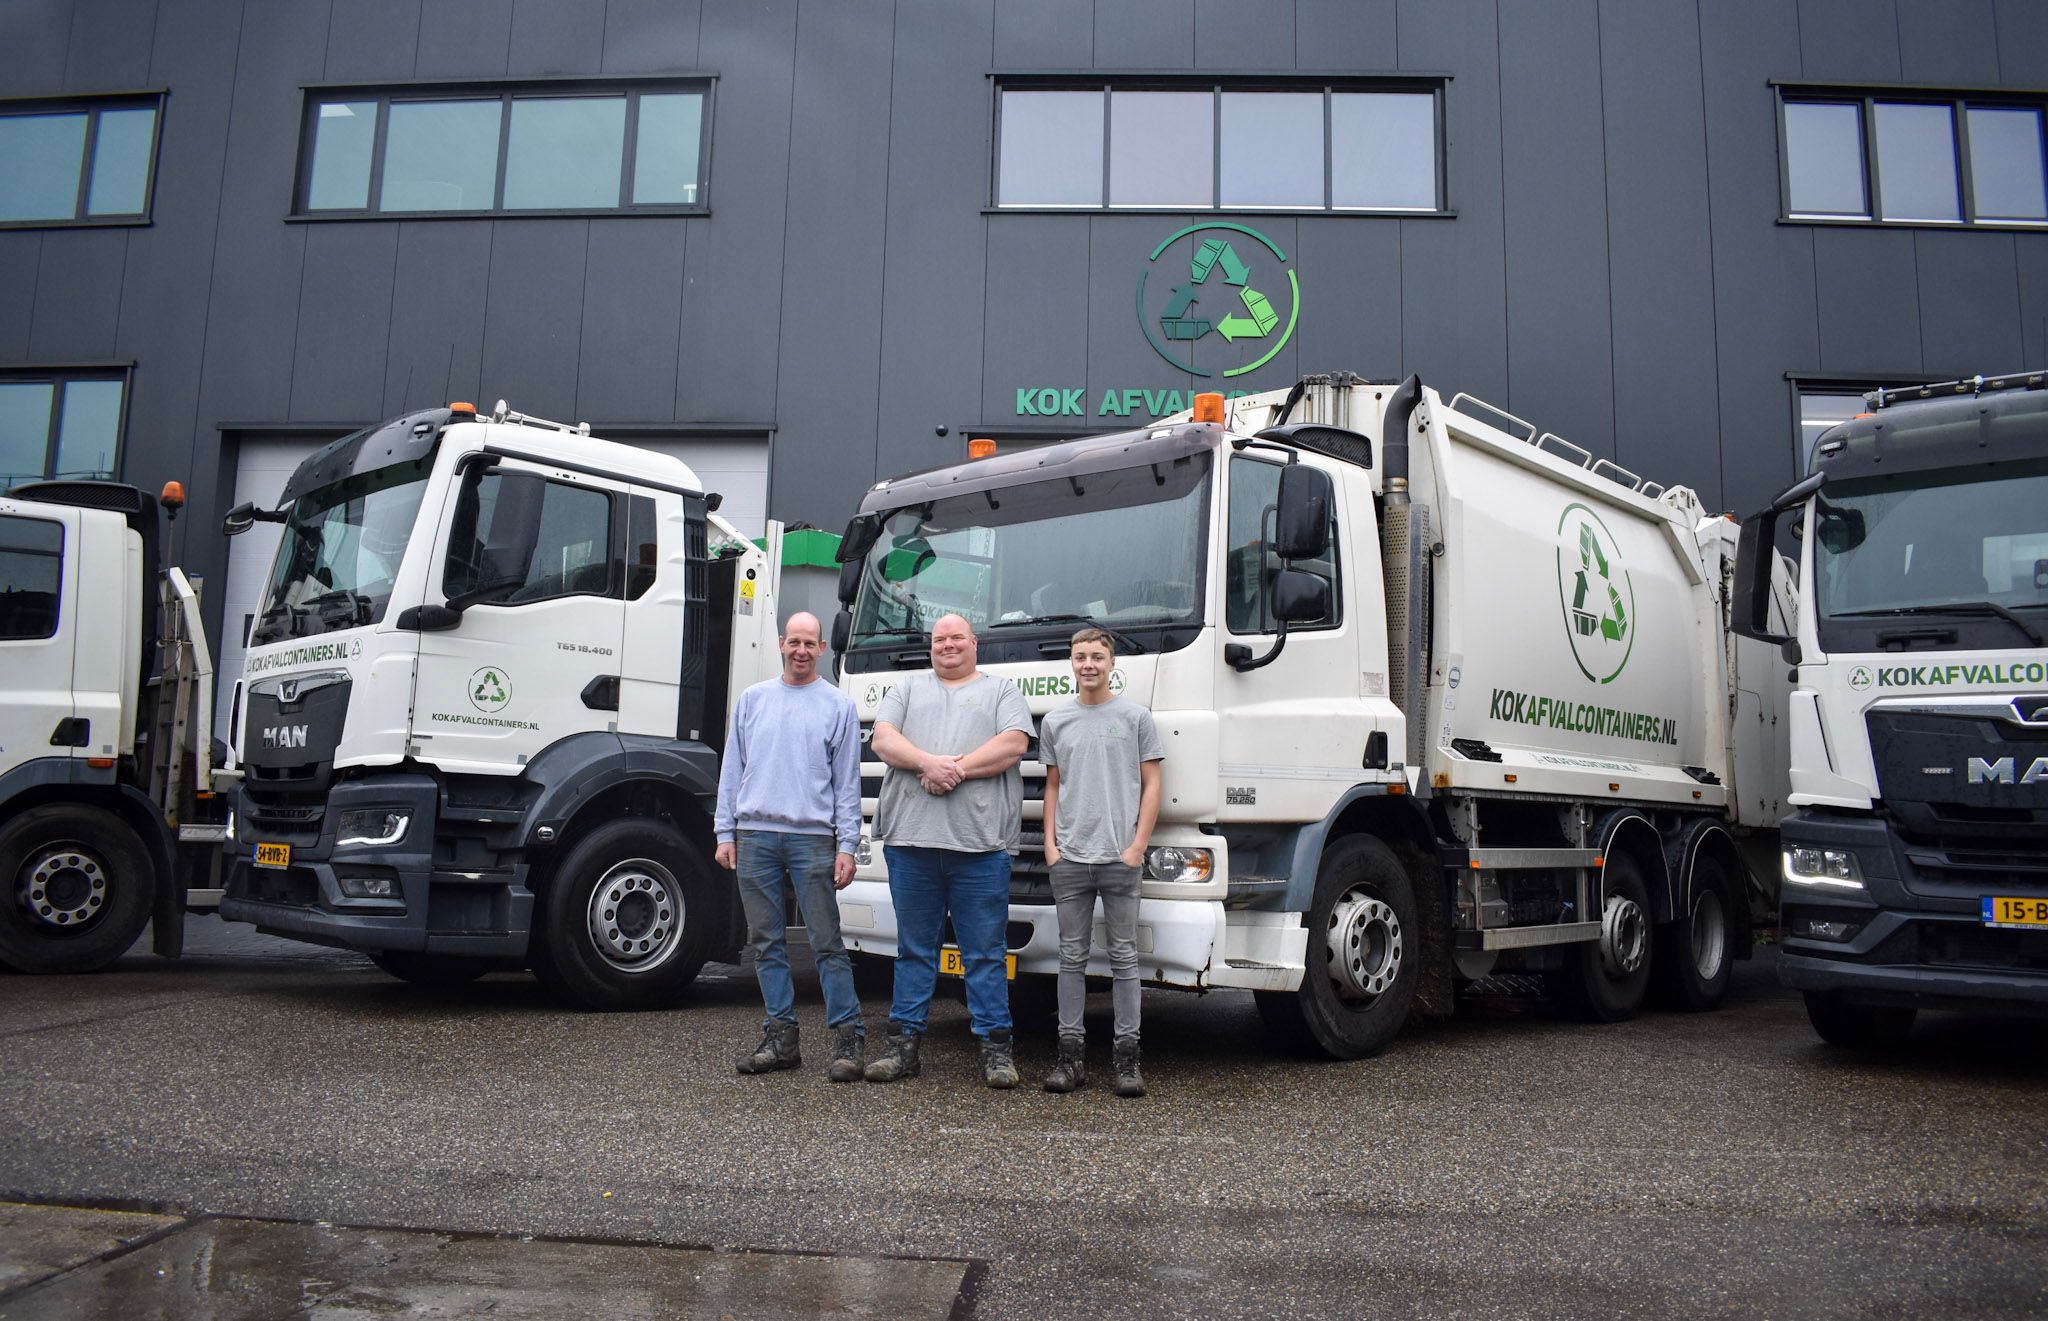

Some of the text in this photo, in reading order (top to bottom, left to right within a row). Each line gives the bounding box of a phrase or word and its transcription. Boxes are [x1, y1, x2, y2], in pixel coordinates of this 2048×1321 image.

[1016, 388, 1084, 416] KOK
[251, 642, 348, 673] KOKAFVALCONTAINERS.NL
[557, 642, 613, 656] TGS 18.400
[1878, 663, 2048, 687] KOKAFVALCO
[432, 713, 540, 731] KOKAFVALCONTAINERS.NL
[1490, 688, 1677, 745] KOKAFVALCONTAINERS.NL
[263, 725, 308, 749] MAN
[2003, 901, 2048, 921] 15-B
